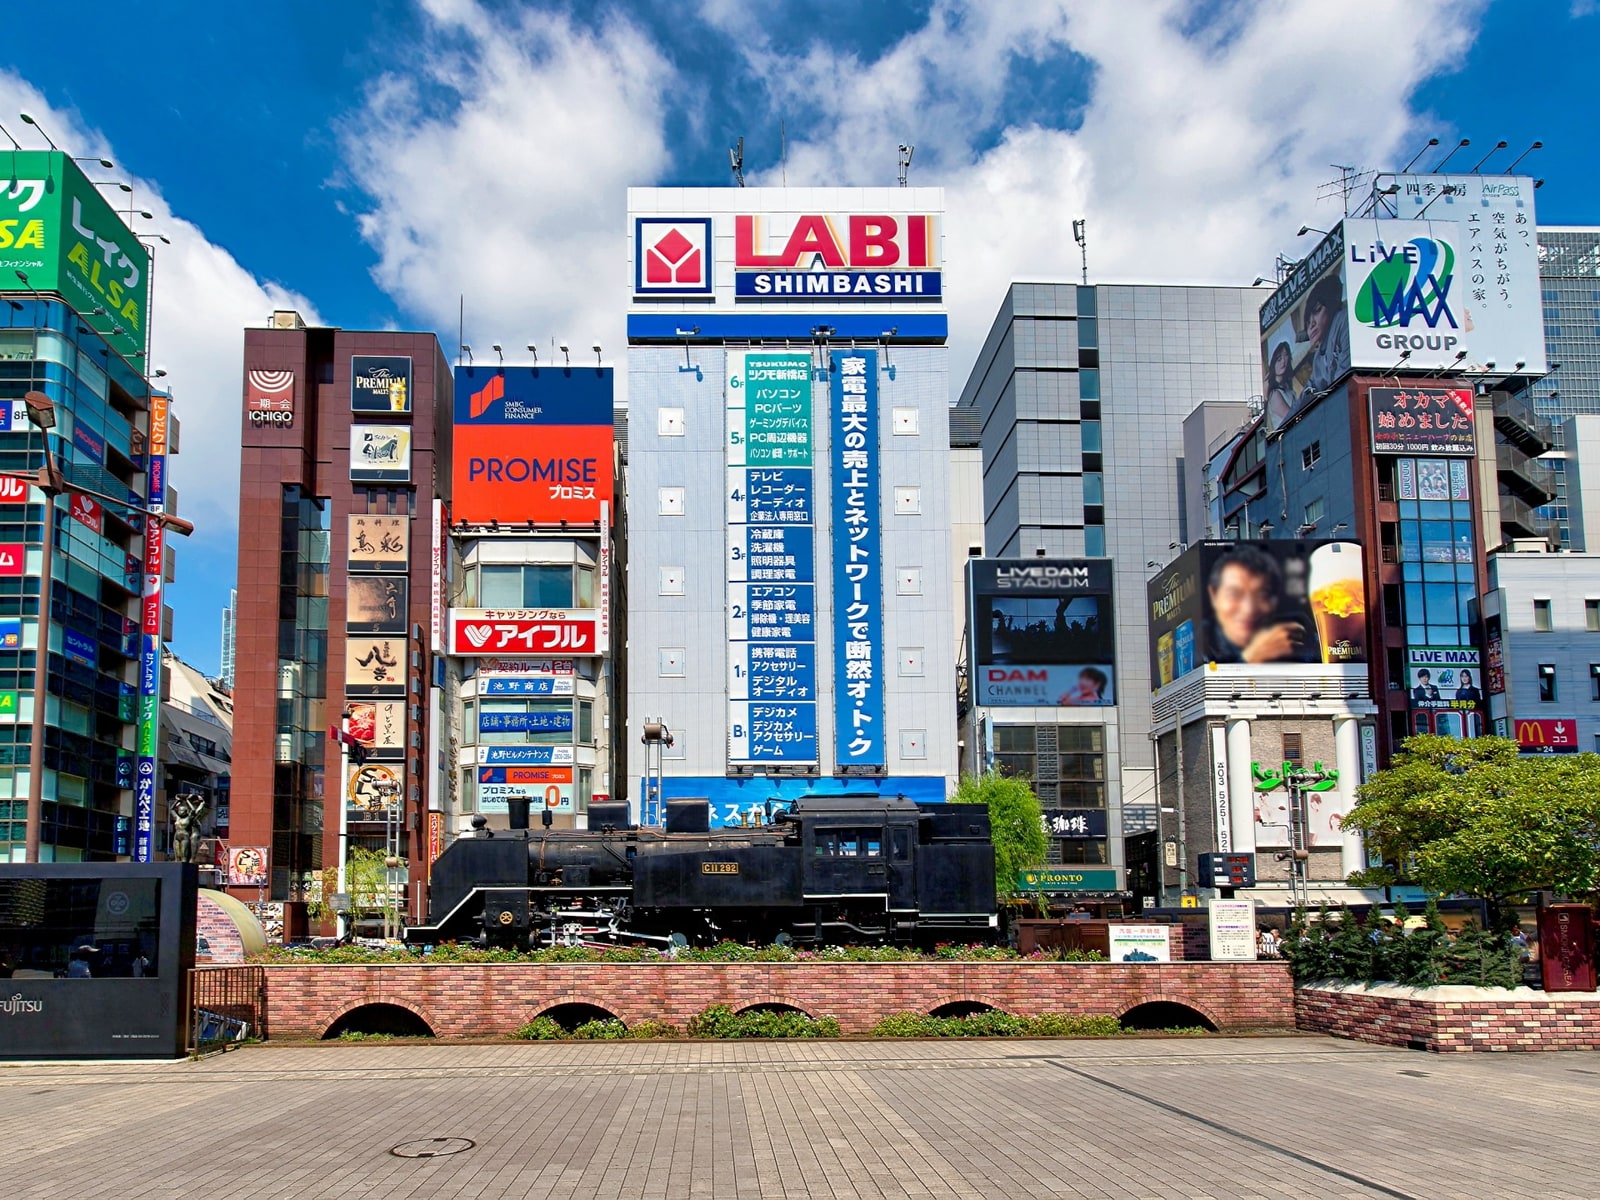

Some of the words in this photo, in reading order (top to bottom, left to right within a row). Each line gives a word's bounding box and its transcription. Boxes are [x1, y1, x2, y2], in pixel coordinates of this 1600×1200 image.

[72, 195, 140, 288] レイク
[735, 215, 927, 267] LABI
[67, 241, 139, 332] ALSA
[754, 274, 923, 294] SHIMBASHI
[1370, 274, 1459, 329] MAX
[1376, 333, 1458, 351] GROUP
[749, 369, 808, 381] ツクモ新橋店
[757, 388, 801, 399] パソコン
[250, 399, 291, 409] 一期一会
[1393, 391, 1450, 409] オカマ
[755, 403, 802, 414] PCパーツ
[249, 411, 292, 421] ICHIGO
[1378, 411, 1469, 430] 始めました
[749, 418, 808, 429] ゲーミングデバイス
[750, 432, 808, 444] PC周辺機器
[469, 458, 597, 482] PROMISE
[751, 472, 784, 482] テレビ
[549, 485, 596, 500] プロミス
[751, 484, 806, 495] レコーダー
[751, 498, 806, 508] オーディオ
[750, 511, 809, 521] 企業法人専用窓口
[751, 528, 785, 540] 冷蔵庫
[751, 542, 785, 553] 洗濯機
[751, 555, 796, 566] 照明器具
[841, 357, 873, 757] 家電最大の売上とネットワークで断然オ・ト・ク
[751, 568, 797, 580] 調理家電
[997, 578, 1090, 588] STADIUM
[752, 586, 797, 597] エアコン
[1153, 573, 1196, 621] PREMIUM
[752, 600, 797, 611] 季節家電
[485, 610, 566, 620] キャッシングなら
[494, 625, 587, 649] アイフル
[752, 626, 792, 638] 健康家電
[751, 647, 798, 660] 携帯電話
[1328, 645, 1362, 655] PREMIUM
[1446, 651, 1478, 662] MAX
[752, 661, 806, 672] アクセサリー
[752, 675, 798, 687] デジタル
[988, 669, 1048, 682] DAM
[493, 681, 549, 691] 池野商店
[752, 686, 809, 697] オーディオ
[988, 685, 1048, 696] CHANNEL
[753, 707, 798, 718] デジカメ
[753, 721, 793, 731] デジカメ
[753, 731, 814, 742] アクセサリー
[1552, 735, 1568, 743] ココ
[753, 745, 784, 756] ゲーム
[1543, 745, 1554, 753] 24
[491, 750, 550, 760] 池野ビルメンテナンス
[512, 771, 550, 779] PROMISE
[482, 786, 526, 795] プロミスなら
[1040, 874, 1083, 882] PRONTO
